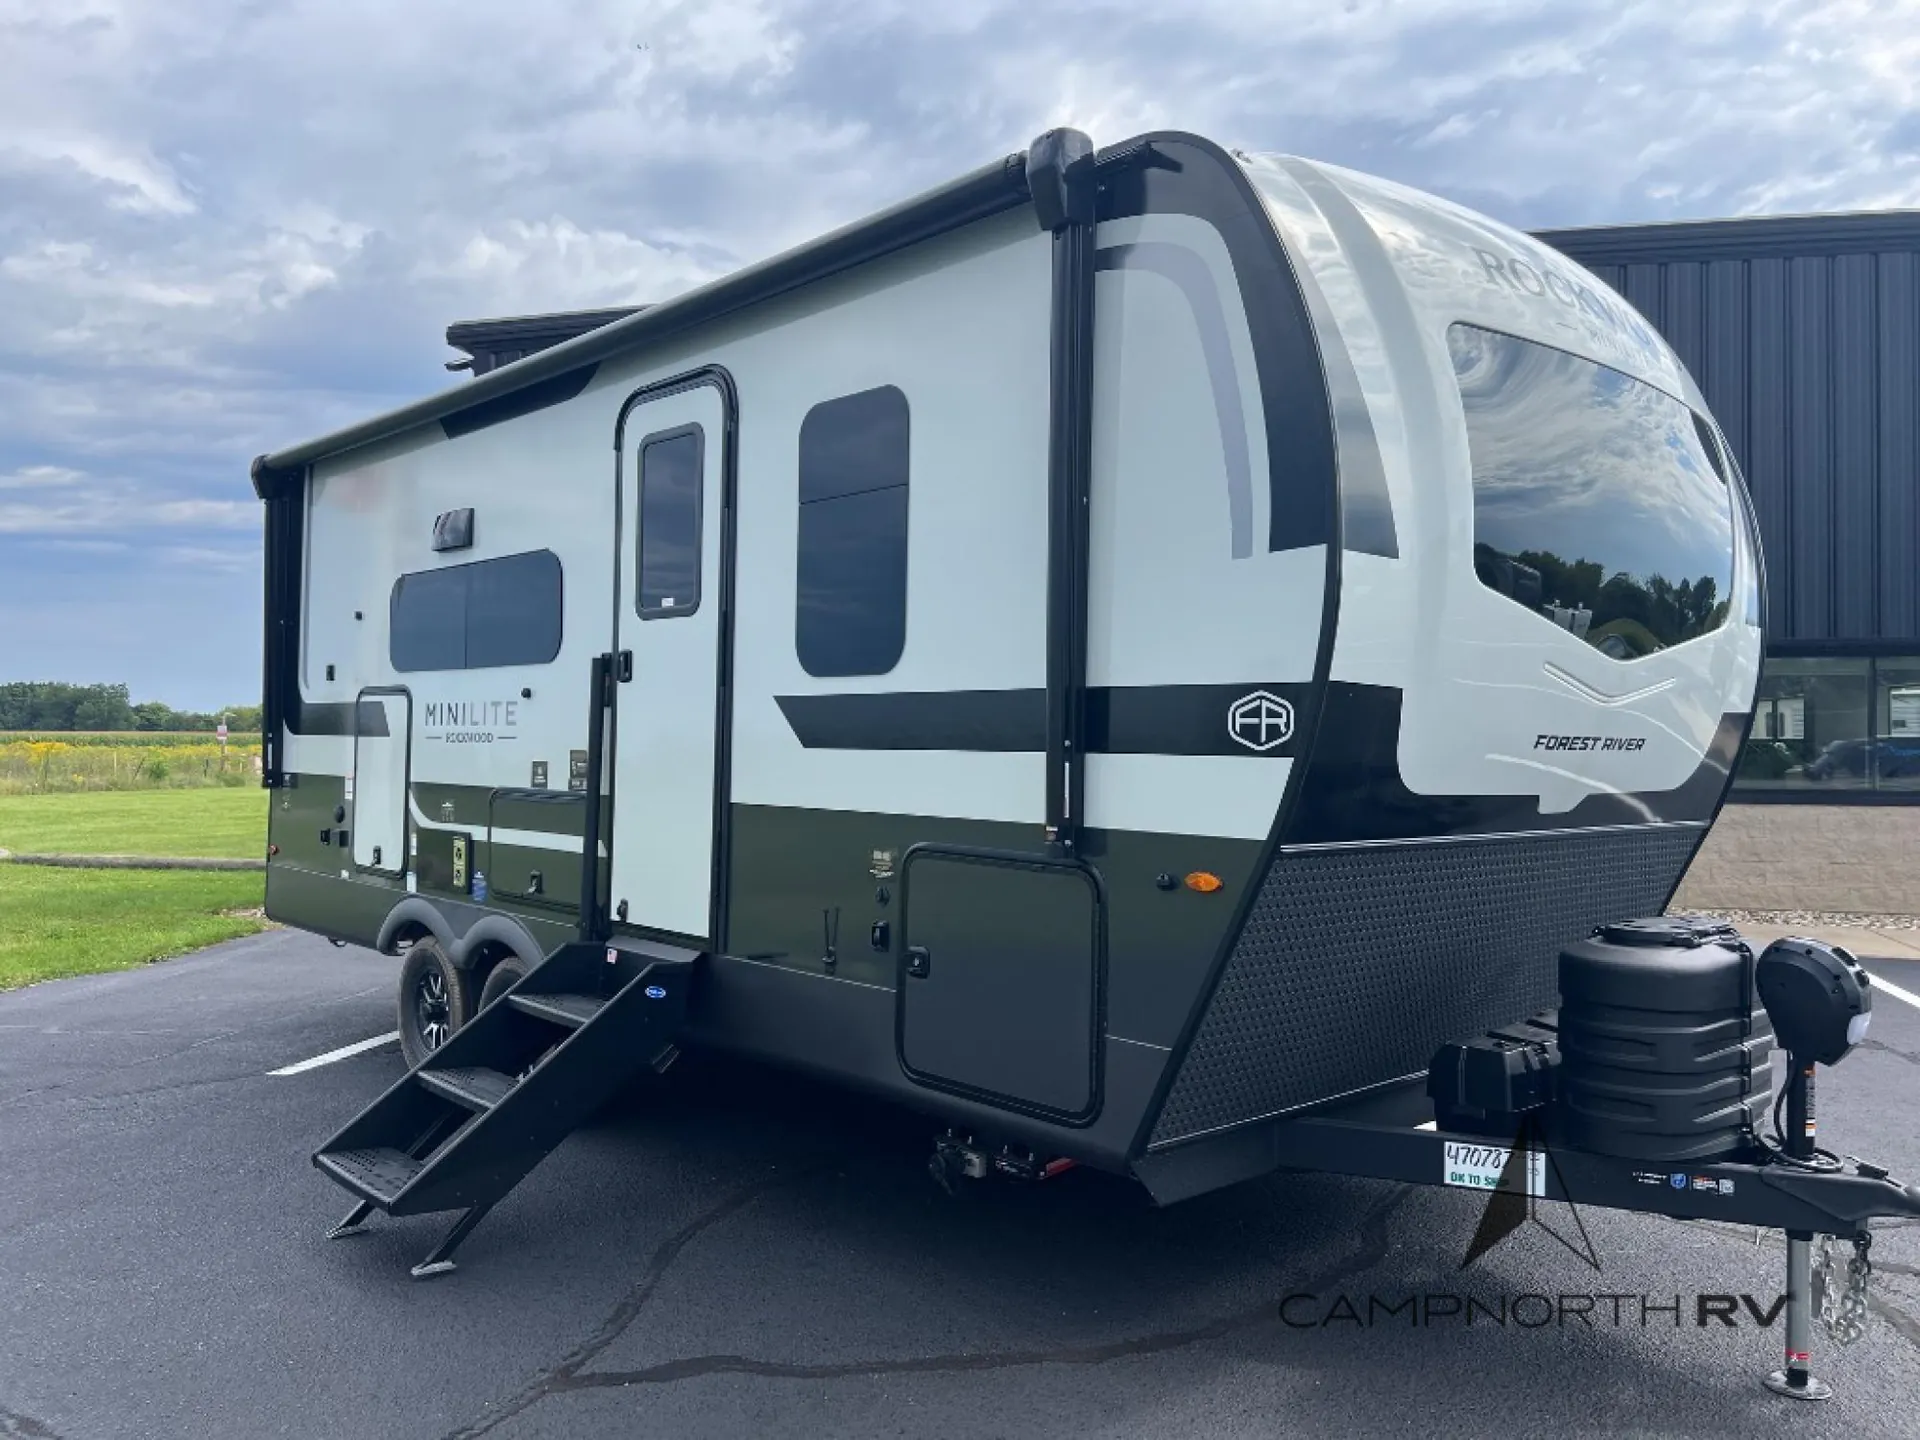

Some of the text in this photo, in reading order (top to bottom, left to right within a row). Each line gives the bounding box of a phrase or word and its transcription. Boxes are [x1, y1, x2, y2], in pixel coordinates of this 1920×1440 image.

[425, 701, 518, 727] MINILITE
[1533, 735, 1647, 751] FOREST RIVER
[1468, 1174, 1480, 1185] TO
